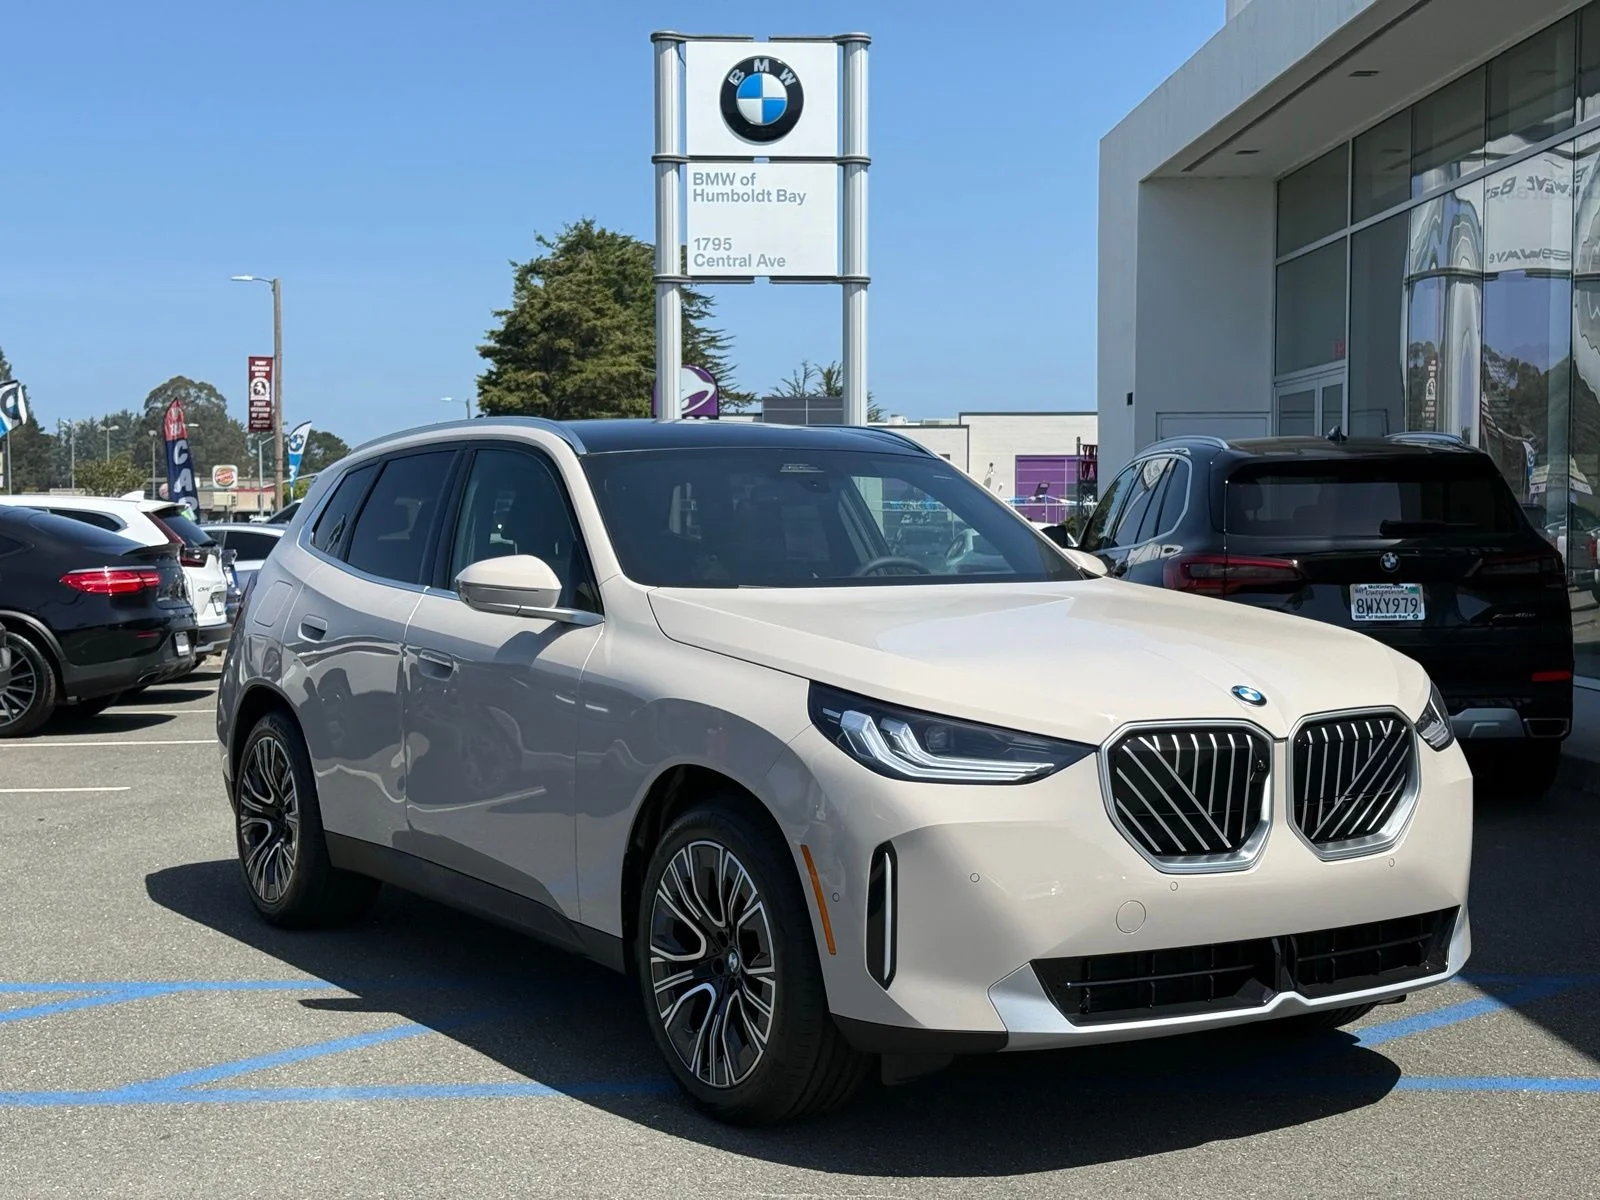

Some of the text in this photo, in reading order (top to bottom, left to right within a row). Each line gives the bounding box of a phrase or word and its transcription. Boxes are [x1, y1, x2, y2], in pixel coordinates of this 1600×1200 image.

[728, 58, 797, 87] BMW
[693, 172, 757, 186] BMW of
[693, 189, 807, 206] Humboldt Bay
[693, 237, 732, 251] 1795
[693, 254, 786, 268] Central Ave
[1356, 597, 1418, 614] 8WXY979
